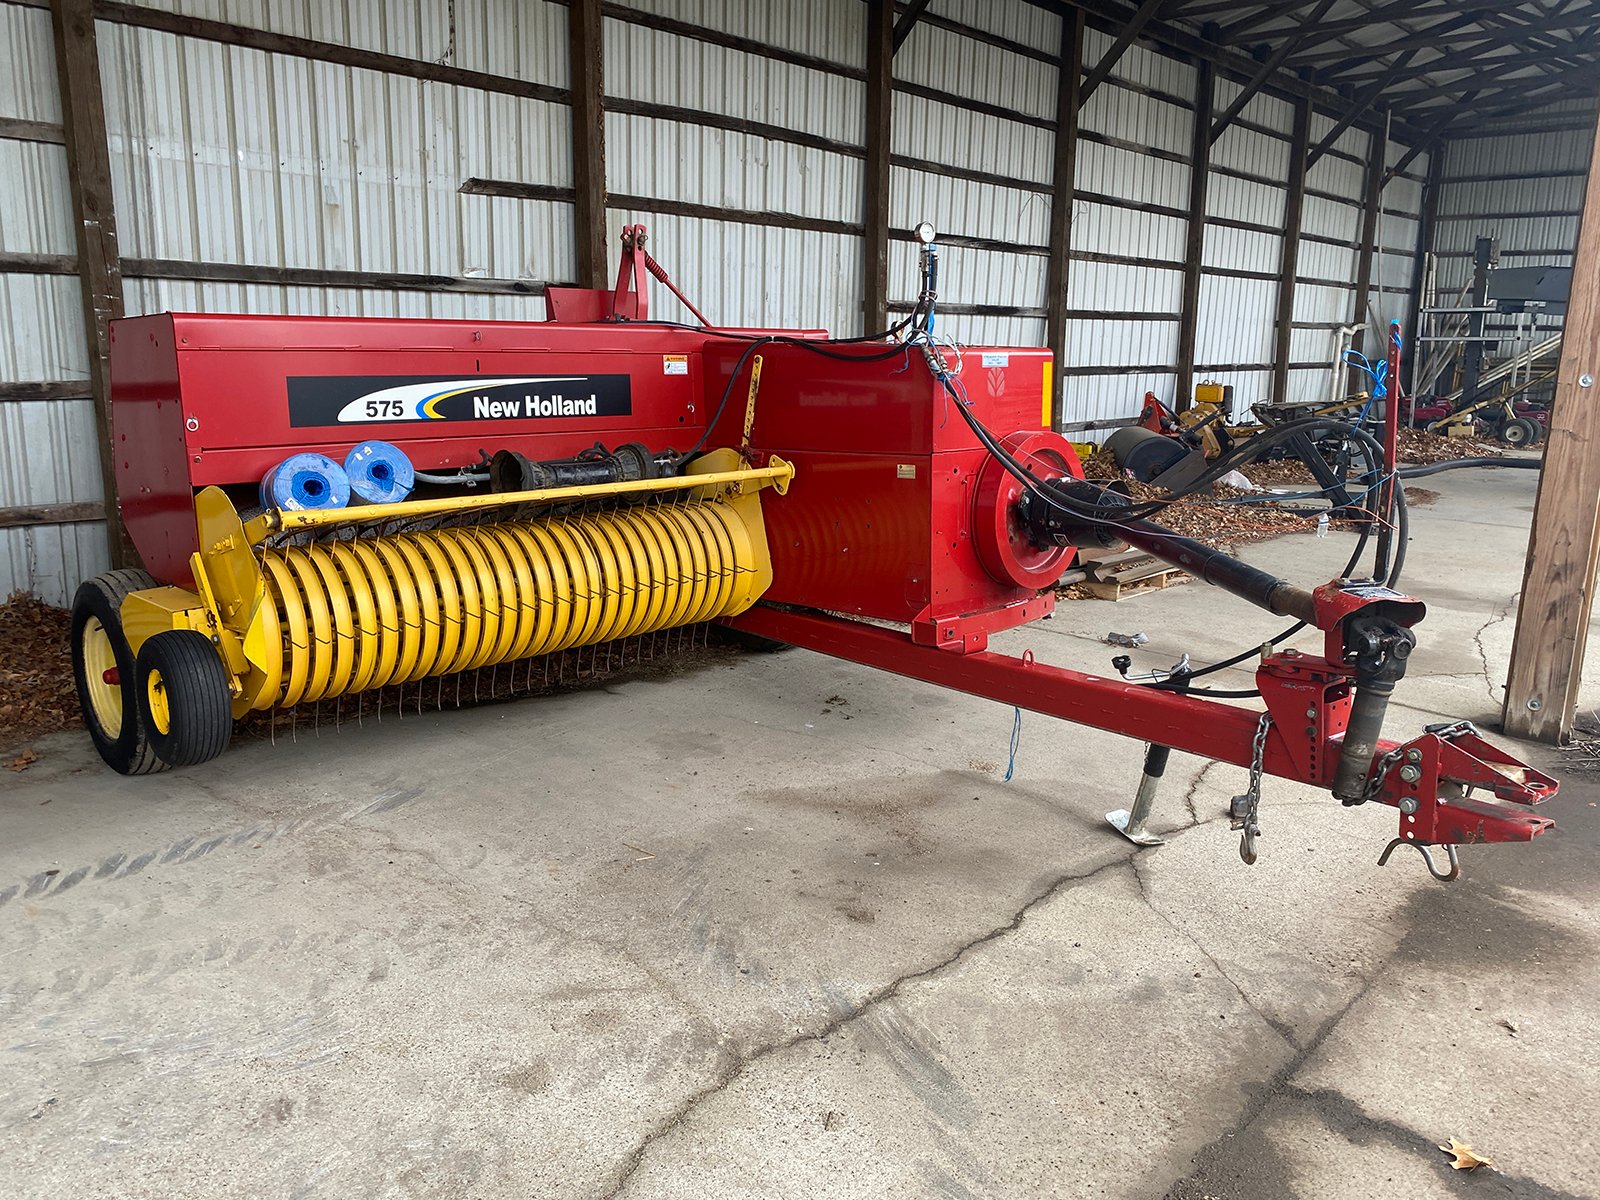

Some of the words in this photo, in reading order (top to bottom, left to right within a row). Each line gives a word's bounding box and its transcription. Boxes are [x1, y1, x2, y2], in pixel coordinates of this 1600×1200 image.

[365, 400, 404, 418] 575
[473, 396, 520, 419] New
[525, 394, 597, 417] Holland
